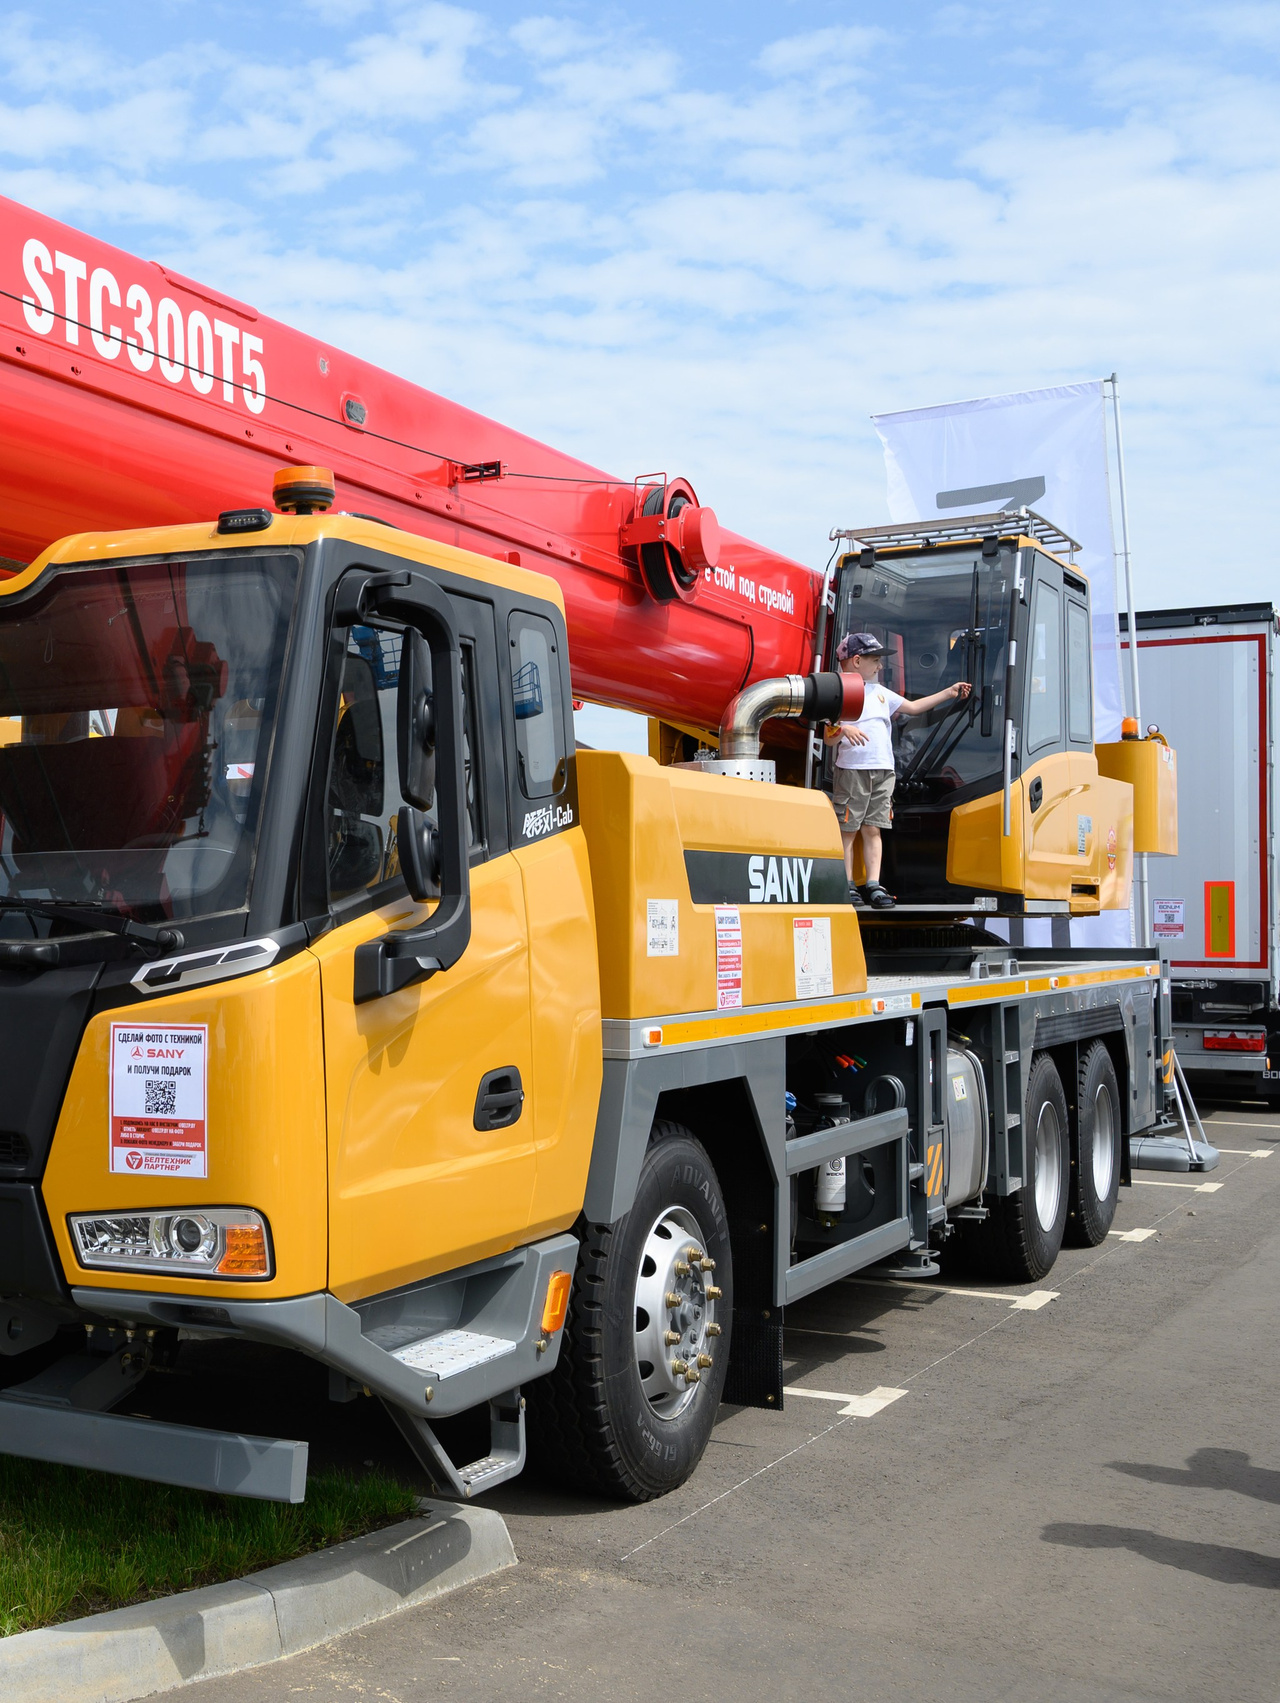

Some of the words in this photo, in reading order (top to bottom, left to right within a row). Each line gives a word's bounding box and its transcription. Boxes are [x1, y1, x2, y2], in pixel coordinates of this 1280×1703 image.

[22, 238, 266, 415] STC300T5
[714, 565, 735, 592] стой
[739, 576, 756, 604] под
[758, 584, 795, 616] стрелой!
[748, 855, 814, 904] SANY
[118, 1032, 144, 1043] СДЕЛАЙ
[145, 1033, 163, 1043] ФОТО
[164, 1034, 169, 1043] С
[170, 1033, 202, 1044] ТЕХНИКОЙ
[146, 1048, 185, 1059] SANY
[127, 1065, 132, 1074] И
[133, 1065, 160, 1075] ПОЛУЧИ
[160, 1066, 192, 1077] ПОДАРОК
[1262, 1070, 1280, 1080] BO
[144, 1157, 192, 1165] БЕЛТЕХНИК
